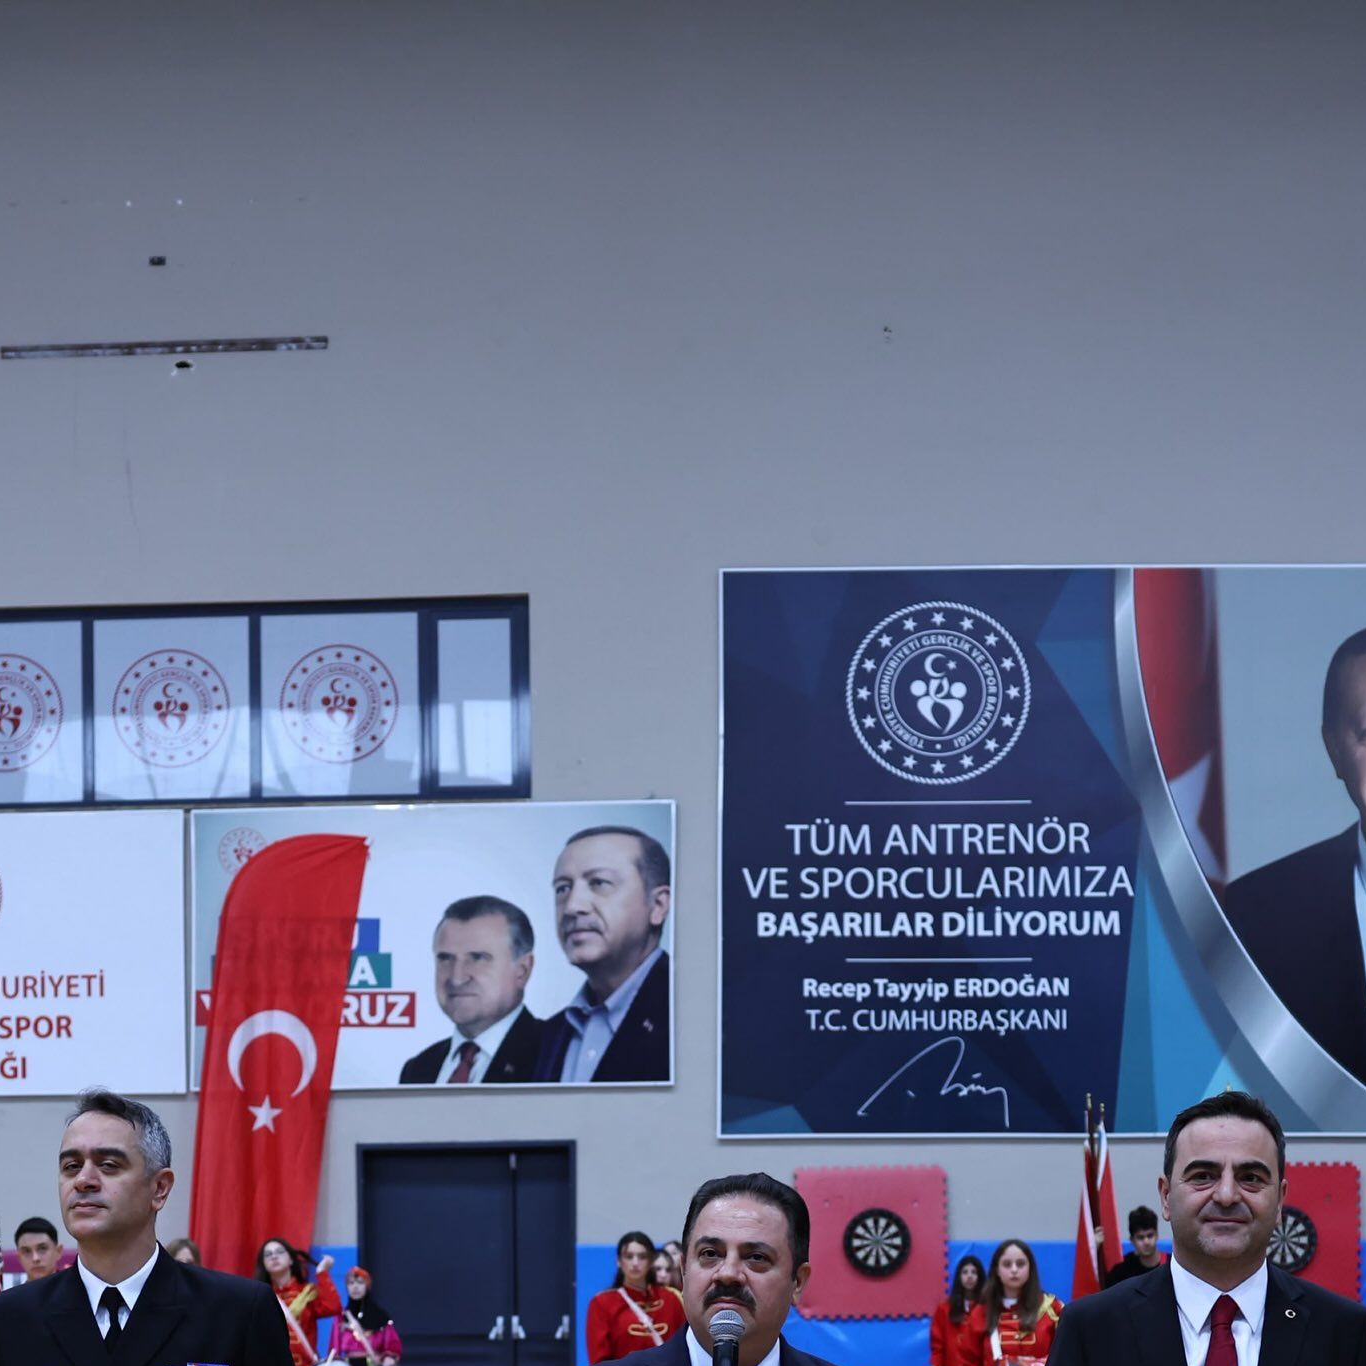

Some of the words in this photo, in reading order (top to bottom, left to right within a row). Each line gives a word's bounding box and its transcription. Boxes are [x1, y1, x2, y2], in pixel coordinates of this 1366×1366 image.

[880, 637, 922, 710] CUMHURİYETİ
[921, 634, 973, 653] GENÇLİK
[971, 648, 985, 664] VE
[981, 662, 998, 694] SPOR
[785, 818, 872, 855] TÜM
[882, 816, 1091, 855] ANTRENÖR
[742, 867, 789, 899] VE
[799, 865, 1135, 899] SPORCULARIMIZA
[756, 911, 935, 943] BAŞARILAR
[942, 906, 1121, 937] DİLİYORUM
[802, 977, 871, 1002] Recep
[873, 977, 949, 1002] Tayyip
[954, 974, 1070, 998] ERDOĞAN
[805, 1009, 847, 1031] T.C.
[852, 1008, 1068, 1036] CUMHURBAŞKANI
